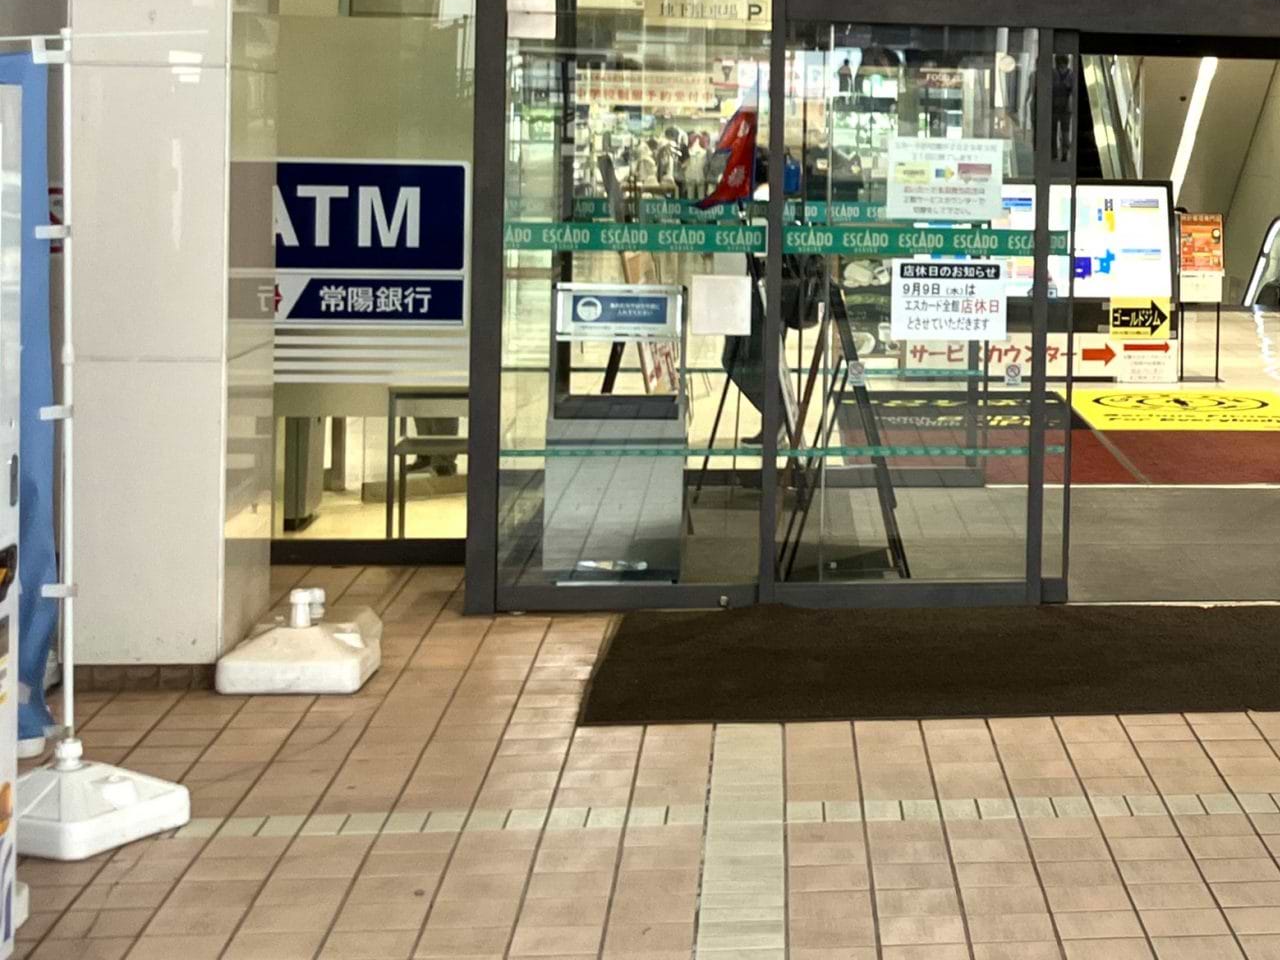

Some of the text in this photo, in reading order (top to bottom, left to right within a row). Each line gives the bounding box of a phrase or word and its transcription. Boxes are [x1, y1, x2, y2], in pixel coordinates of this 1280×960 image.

[747, 3, 762, 21] P
[272, 184, 421, 248] ATM
[543, 225, 591, 244] ESCADO
[601, 226, 649, 245] ESCADO
[658, 227, 706, 246] ESCADO
[716, 227, 762, 246] ESCADO
[787, 229, 833, 247] ESCADO
[843, 230, 890, 248] ESCADO
[898, 230, 943, 248] ESCADO
[953, 231, 998, 249] ESCADO
[903, 265, 997, 278] 店休日のお知らせ
[319, 285, 432, 313] 常陽銀行
[907, 317, 990, 331] とさせていただきます
[1112, 308, 1162, 328] ゴールドジム
